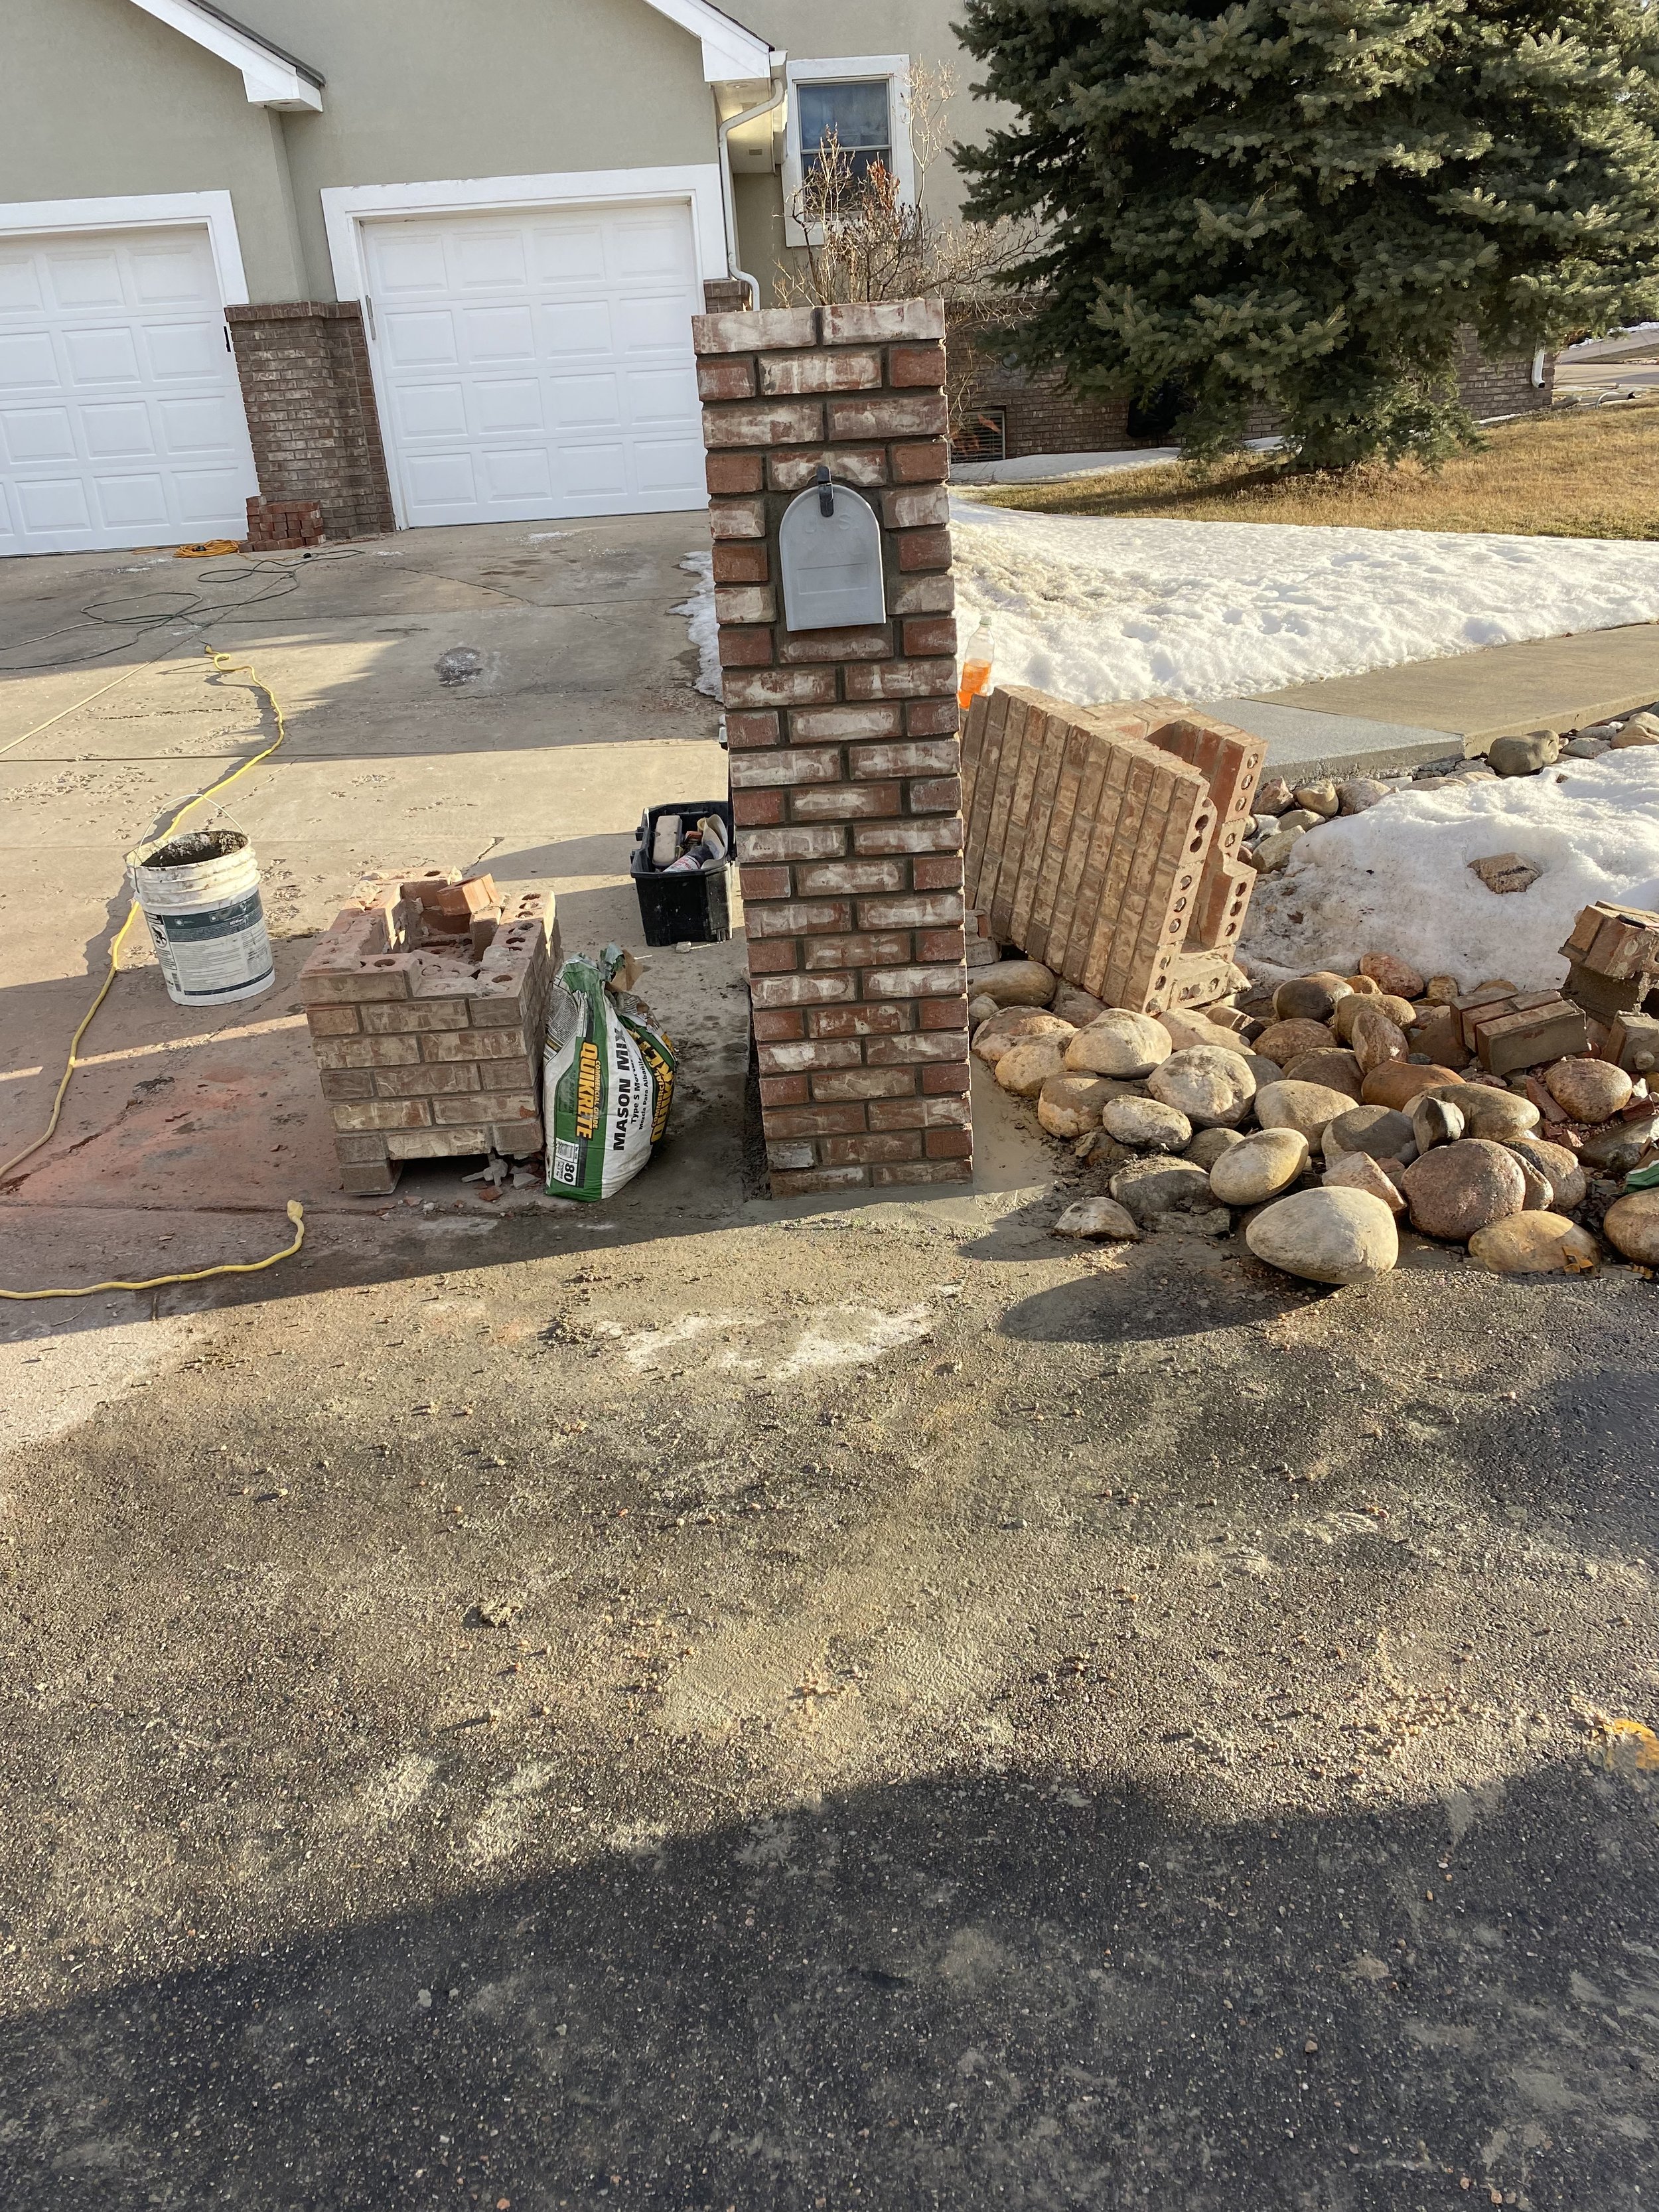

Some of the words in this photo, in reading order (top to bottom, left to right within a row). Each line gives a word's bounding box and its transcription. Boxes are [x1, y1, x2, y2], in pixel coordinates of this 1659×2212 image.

[614, 1027, 630, 1071] MIX
[576, 1042, 599, 1140] QUIKRETE
[651, 1070, 665, 1128] COMMERCIAL
[613, 1078, 631, 1151] MASON
[630, 1103, 640, 1124] Type
[638, 1107, 647, 1130] Mezcla
[564, 1163, 575, 1183] 80
